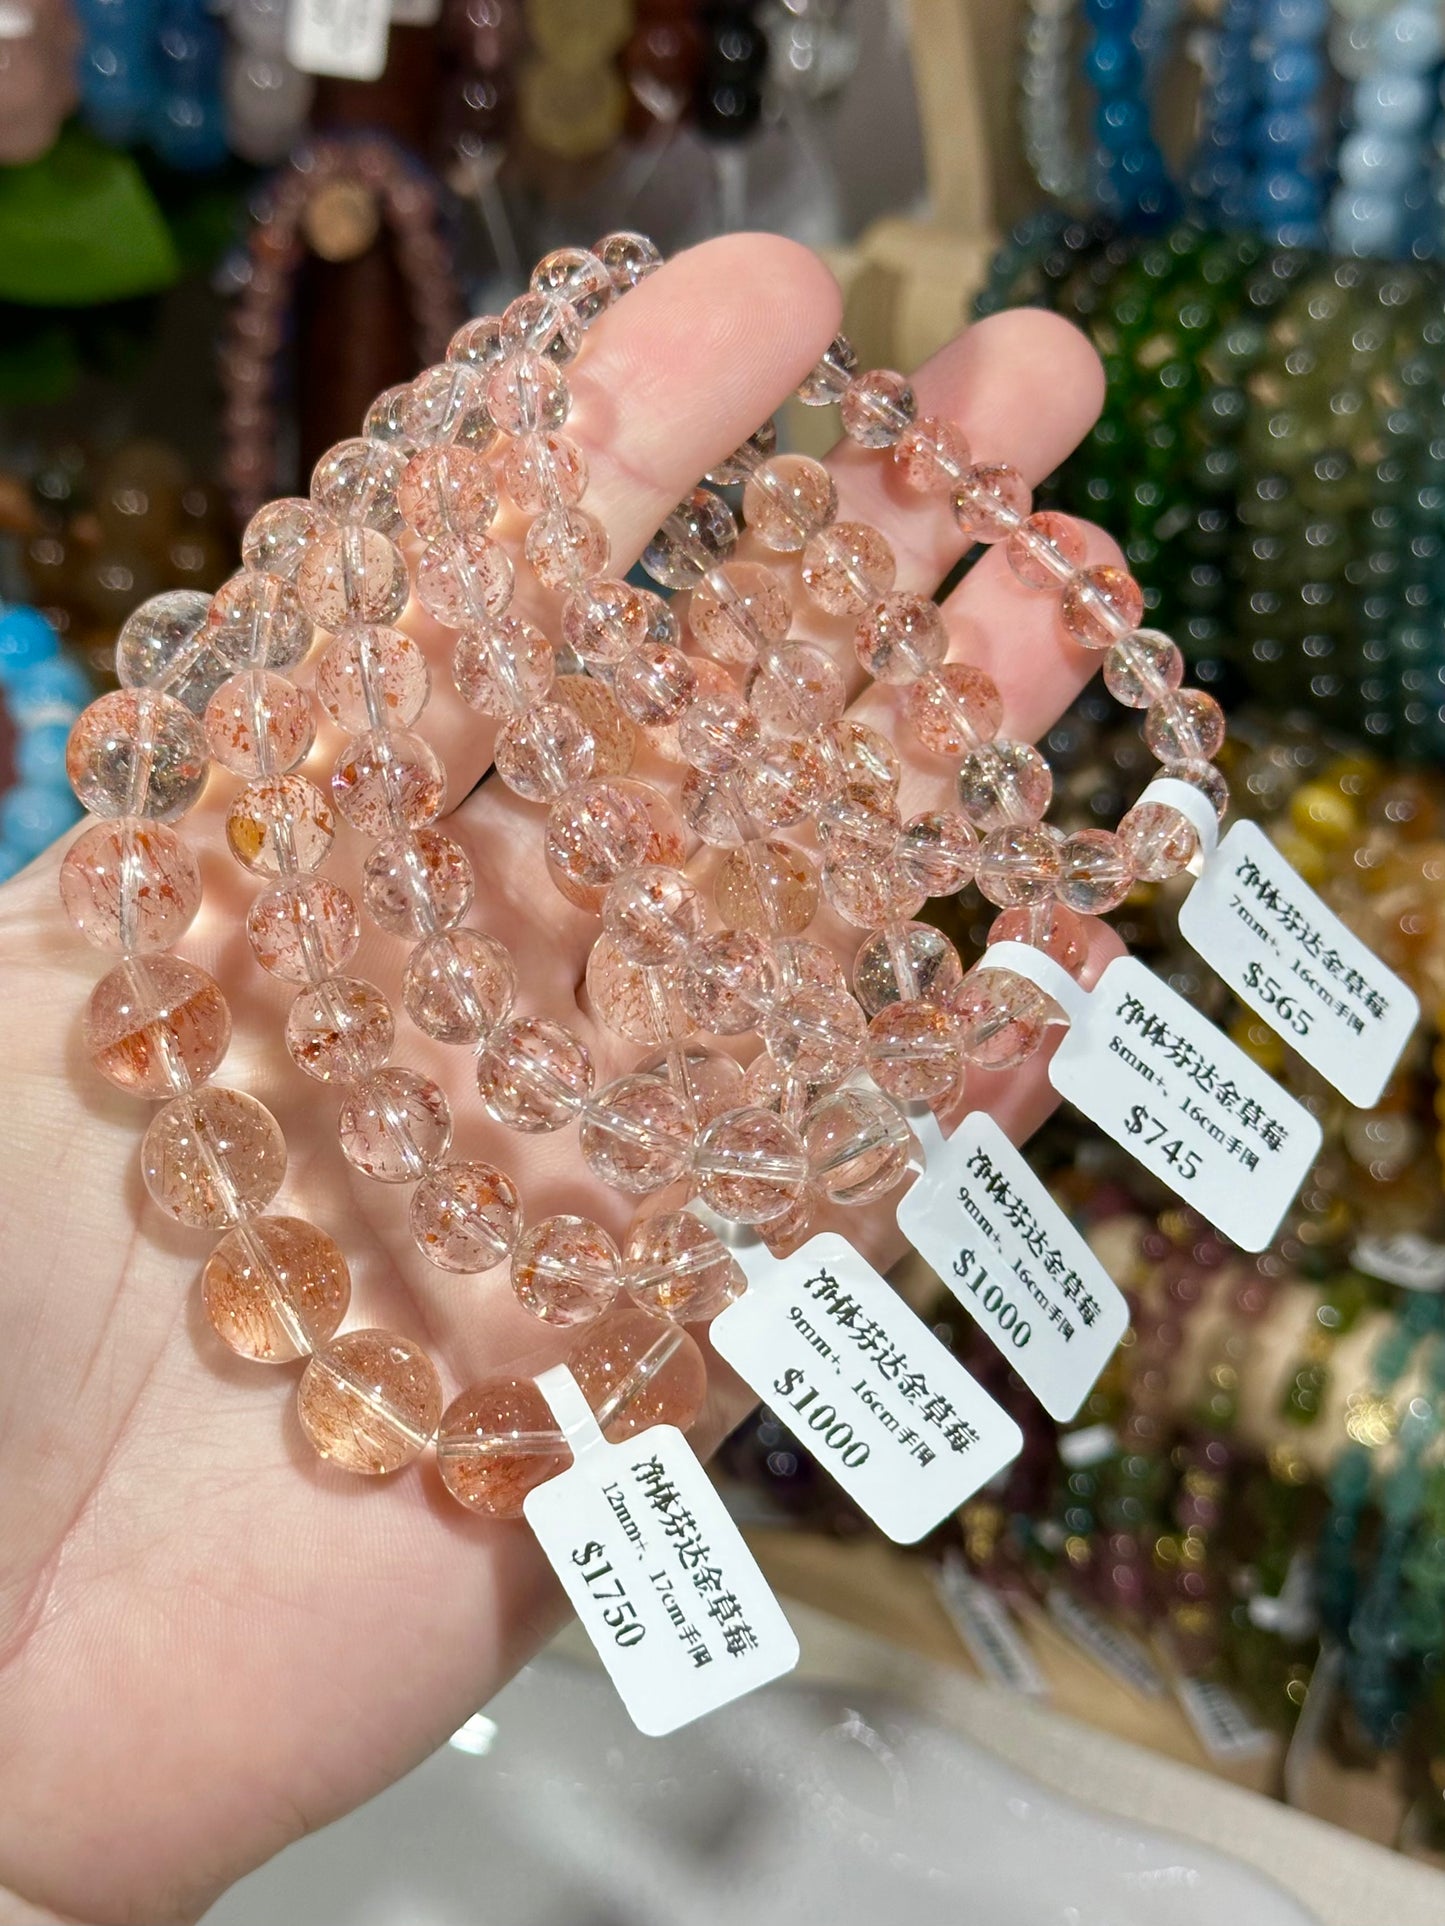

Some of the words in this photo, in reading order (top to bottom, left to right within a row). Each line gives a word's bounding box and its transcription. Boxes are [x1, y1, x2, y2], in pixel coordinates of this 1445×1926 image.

[1235, 855, 1390, 1021] 净体芬达金草莓
[1242, 961, 1315, 1036] $565
[1115, 992, 1289, 1153] 净体芬达金草莓
[1124, 1104, 1203, 1180] $745
[953, 1248, 1032, 1348] $1000
[966, 1146, 1101, 1327] 净体芬达金草莓
[773, 1368, 870, 1468] $1000
[803, 1267, 980, 1454] 净体芬达金草莓
[570, 1541, 646, 1647] $1750
[631, 1454, 759, 1658] 净体芬达金草莓
